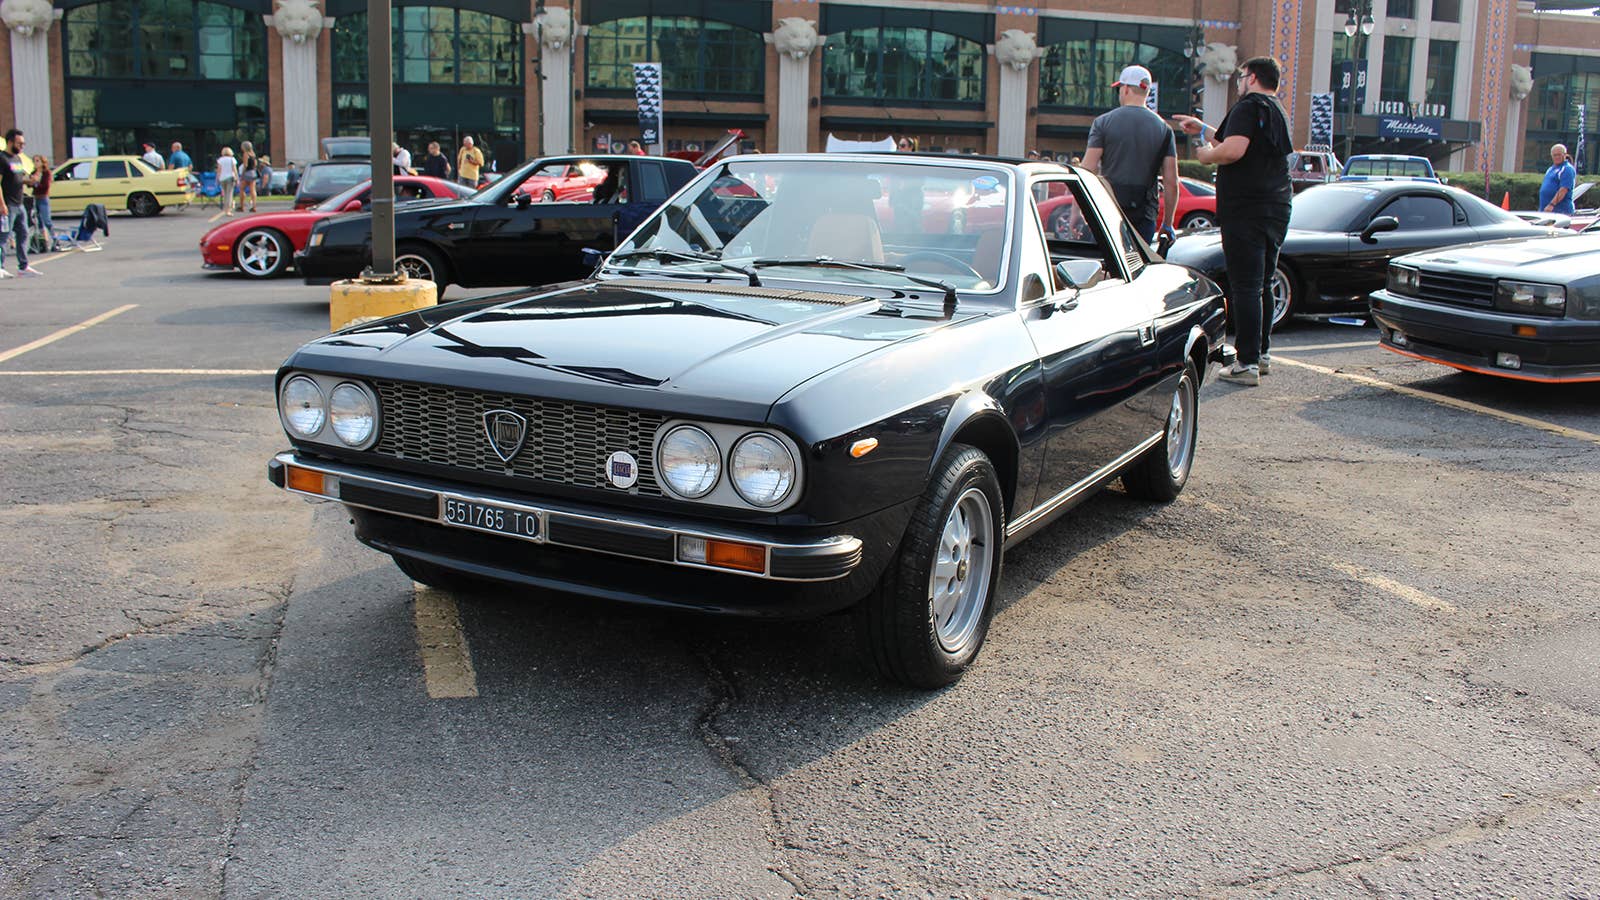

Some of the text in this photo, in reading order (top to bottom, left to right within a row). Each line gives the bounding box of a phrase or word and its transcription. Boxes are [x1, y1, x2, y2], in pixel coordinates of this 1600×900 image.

[1373, 101, 1446, 117] TIGER CLUB
[447, 500, 536, 536] 551765 TO
